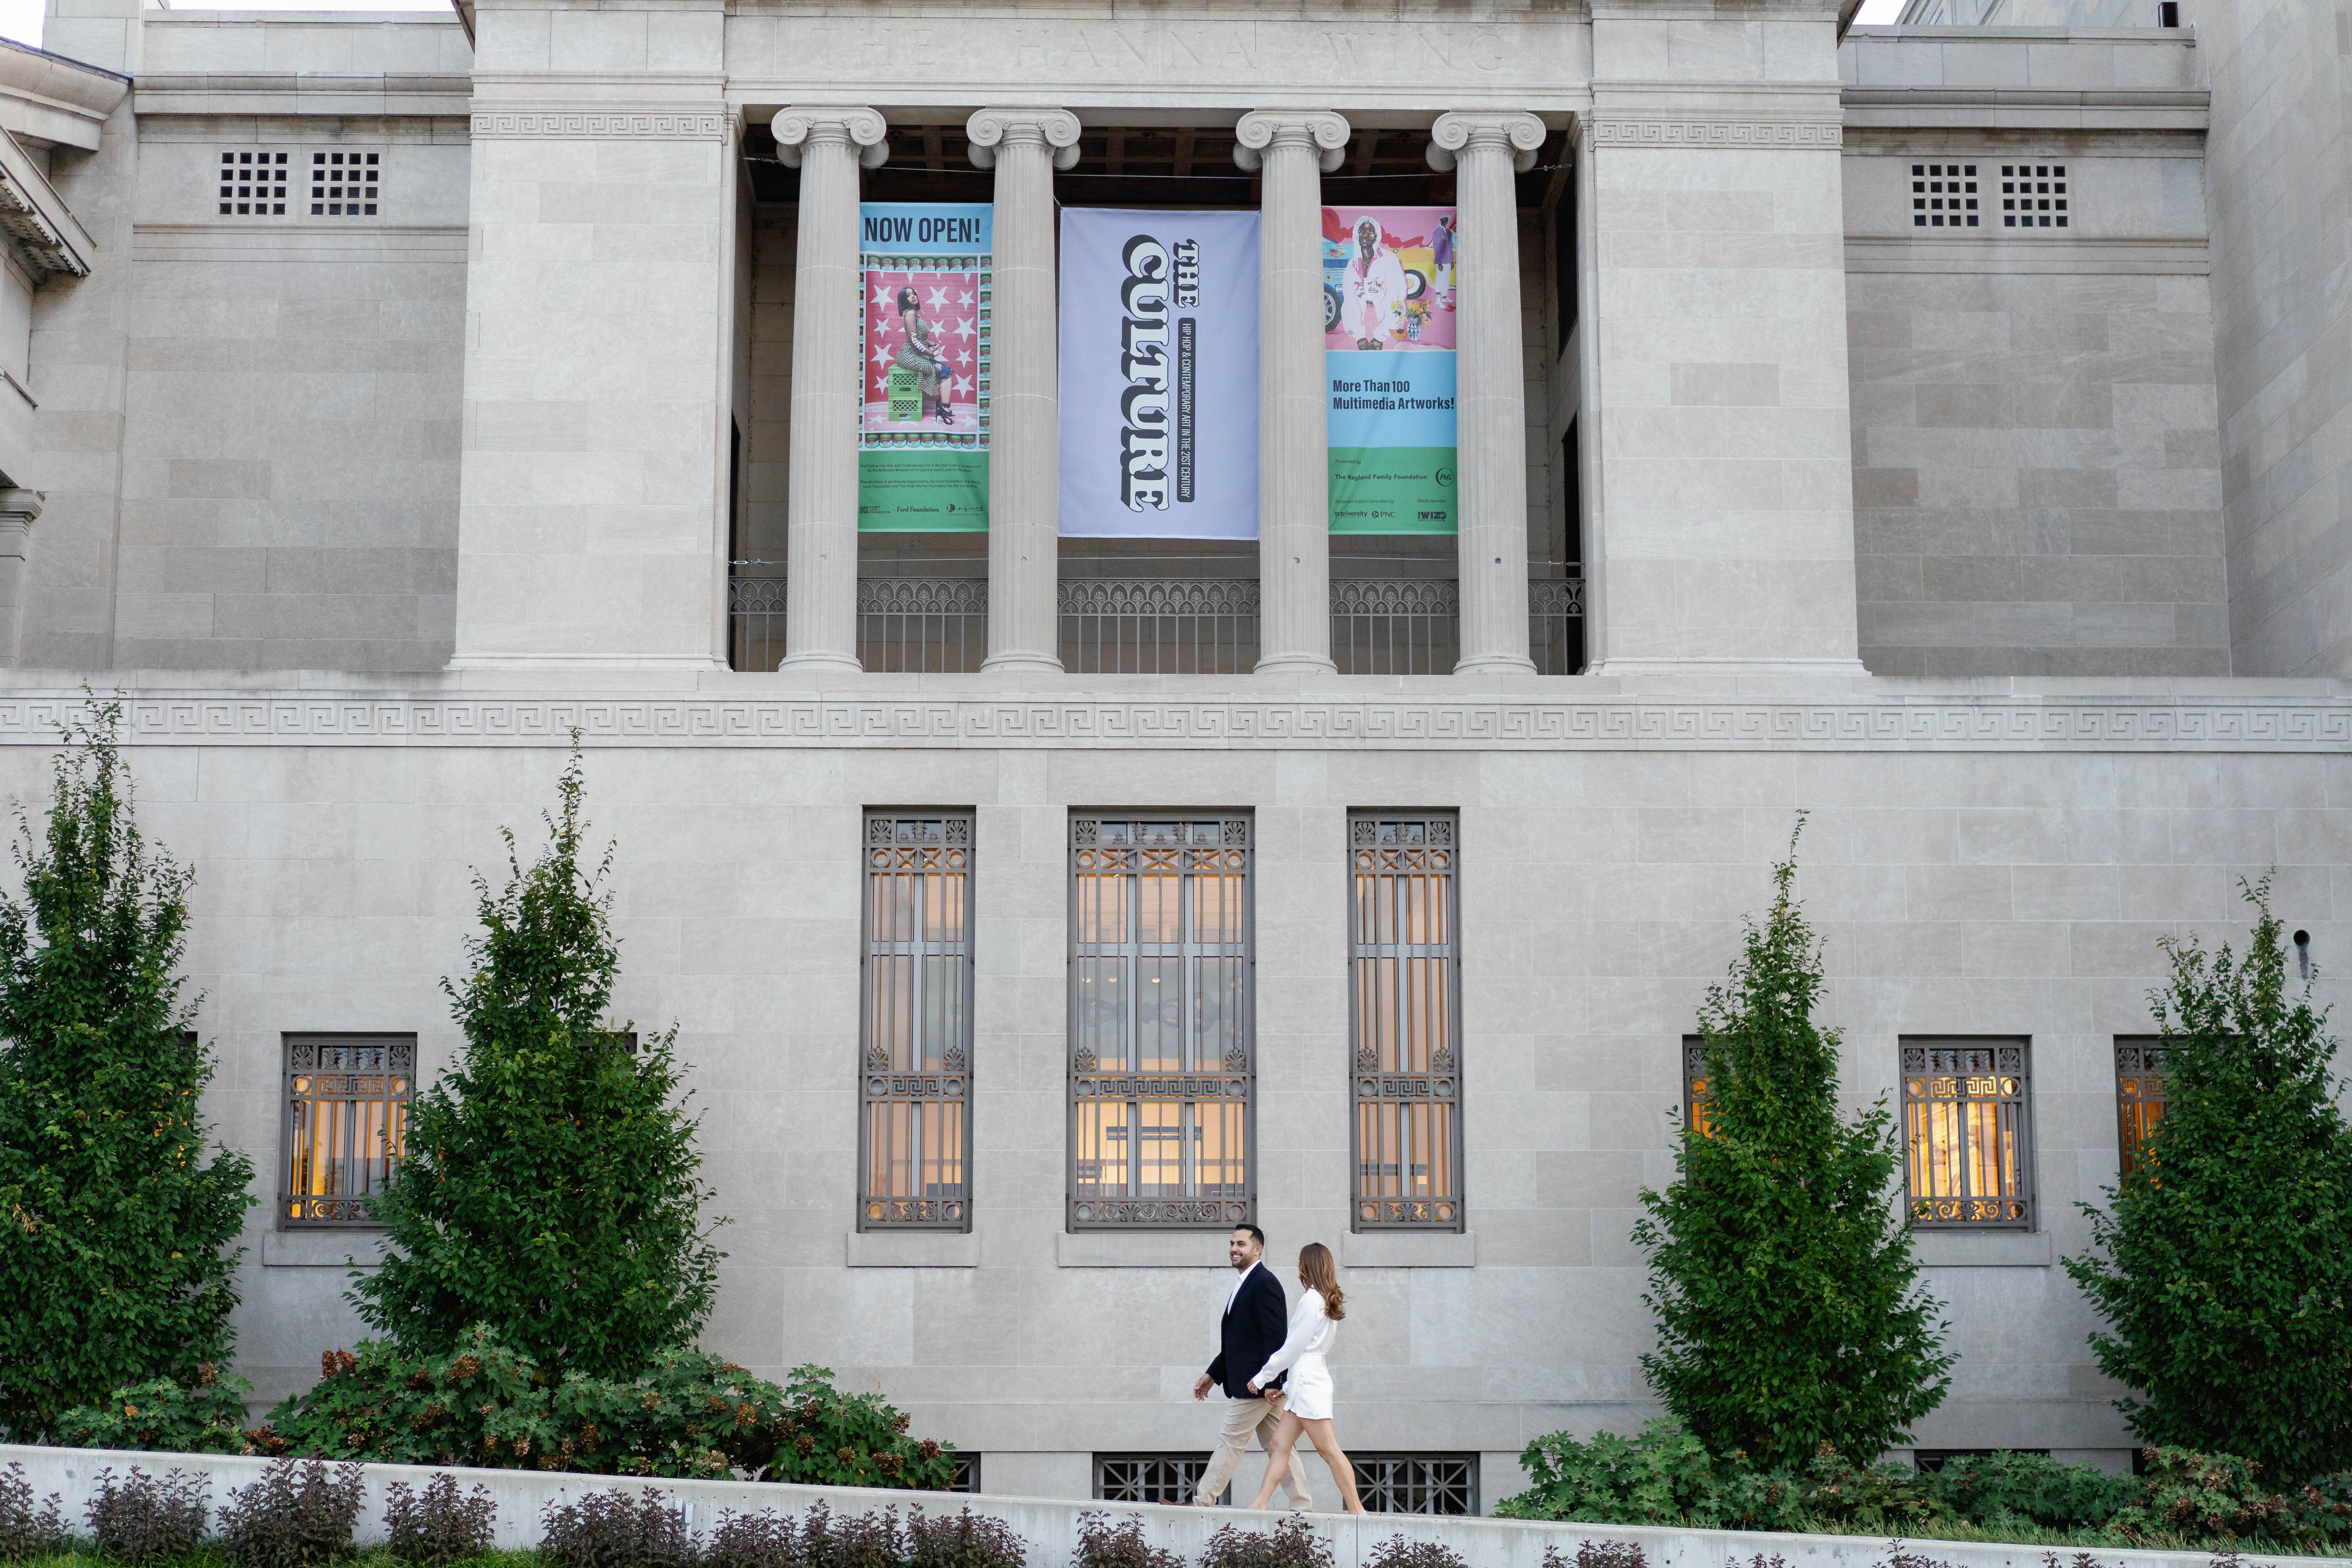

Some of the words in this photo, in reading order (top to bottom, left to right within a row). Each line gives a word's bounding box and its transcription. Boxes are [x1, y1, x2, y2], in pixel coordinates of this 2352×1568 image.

[810, 28, 937, 66] THE
[1012, 30, 1258, 69] HANNA
[1321, 32, 1505, 71] WING
[865, 218, 913, 242] NOW
[919, 218, 980, 242] OPEN!
[1173, 239, 1200, 308] THE
[1182, 323, 1191, 335] HIP
[910, 332, 926, 352] UNITY
[1182, 337, 1191, 350] HOP
[1121, 235, 1170, 513] CULTURE
[1182, 359, 1191, 414] CONTEMPORARY
[1333, 380, 1361, 392] More
[1363, 380, 1390, 392] Than
[1392, 381, 1410, 393] 100
[1333, 397, 1395, 410] Multimedia
[1398, 397, 1454, 410] Artworks!
[1181, 415, 1191, 427] ART
[1181, 438, 1190, 450] THE
[1181, 451, 1190, 466] 21ST
[1181, 467, 1190, 498] CENTURY
